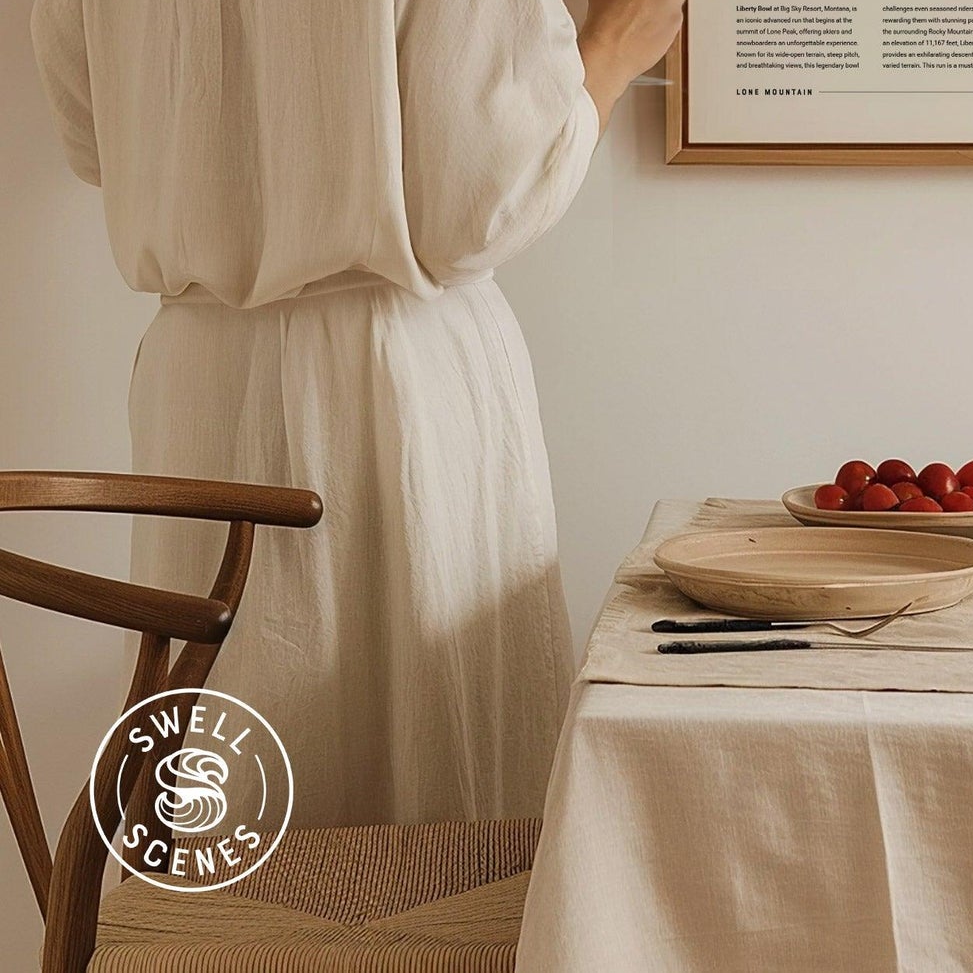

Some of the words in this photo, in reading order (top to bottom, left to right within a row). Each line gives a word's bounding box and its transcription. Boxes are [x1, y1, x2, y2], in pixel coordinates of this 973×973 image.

[736, 5, 757, 13] Liberty
[781, 5, 790, 13] Big
[791, 5, 801, 13] Sky
[882, 5, 913, 13] challenges
[816, 17, 835, 25] begins
[883, 17, 911, 25] rewarding
[942, 17, 966, 25] stunning
[799, 28, 821, 36] offering
[893, 28, 927, 36] surrounding
[929, 28, 946, 36] Rocky
[827, 51, 843, 59] steep
[882, 51, 907, 59] provides
[917, 51, 950, 59] exhilarating
[749, 62, 784, 70] breathtaking
[816, 62, 844, 70] legendary
